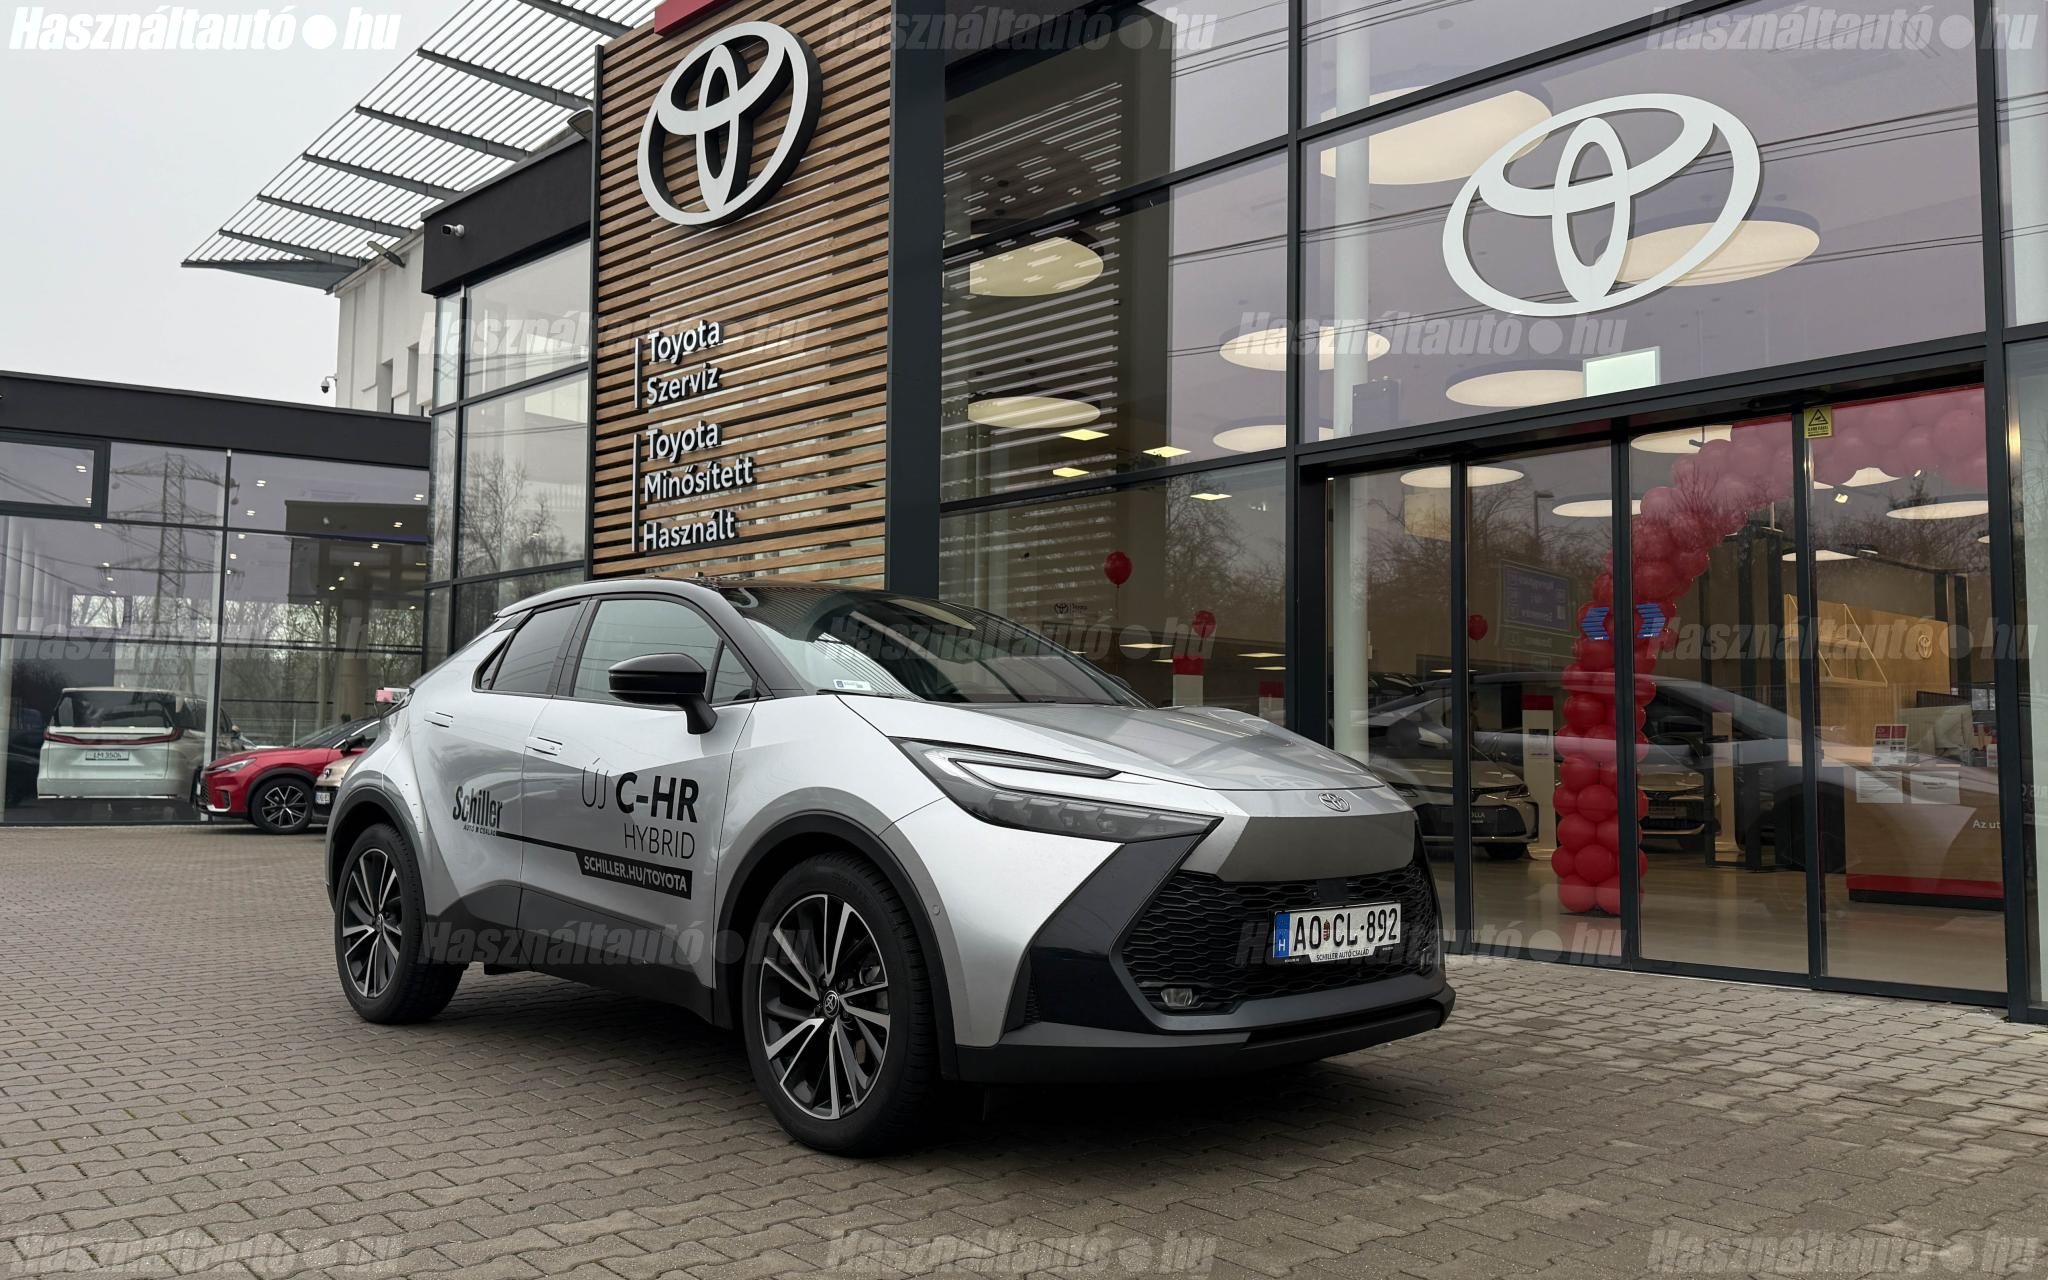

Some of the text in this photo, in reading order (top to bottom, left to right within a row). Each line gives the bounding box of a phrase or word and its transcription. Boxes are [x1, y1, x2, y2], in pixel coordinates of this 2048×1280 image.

[648, 320, 722, 364] Toyota
[647, 362, 720, 405] Szerviz
[646, 420, 720, 463] Toyota
[644, 457, 754, 502] Minősített
[643, 509, 736, 551] Használt
[453, 785, 503, 829] Schiller
[582, 757, 699, 823] ÚJ C-HR
[624, 822, 696, 859] HYBRID
[584, 855, 688, 892] SCHILLER.HU/TOYOTA
[1293, 915, 1322, 952] AO
